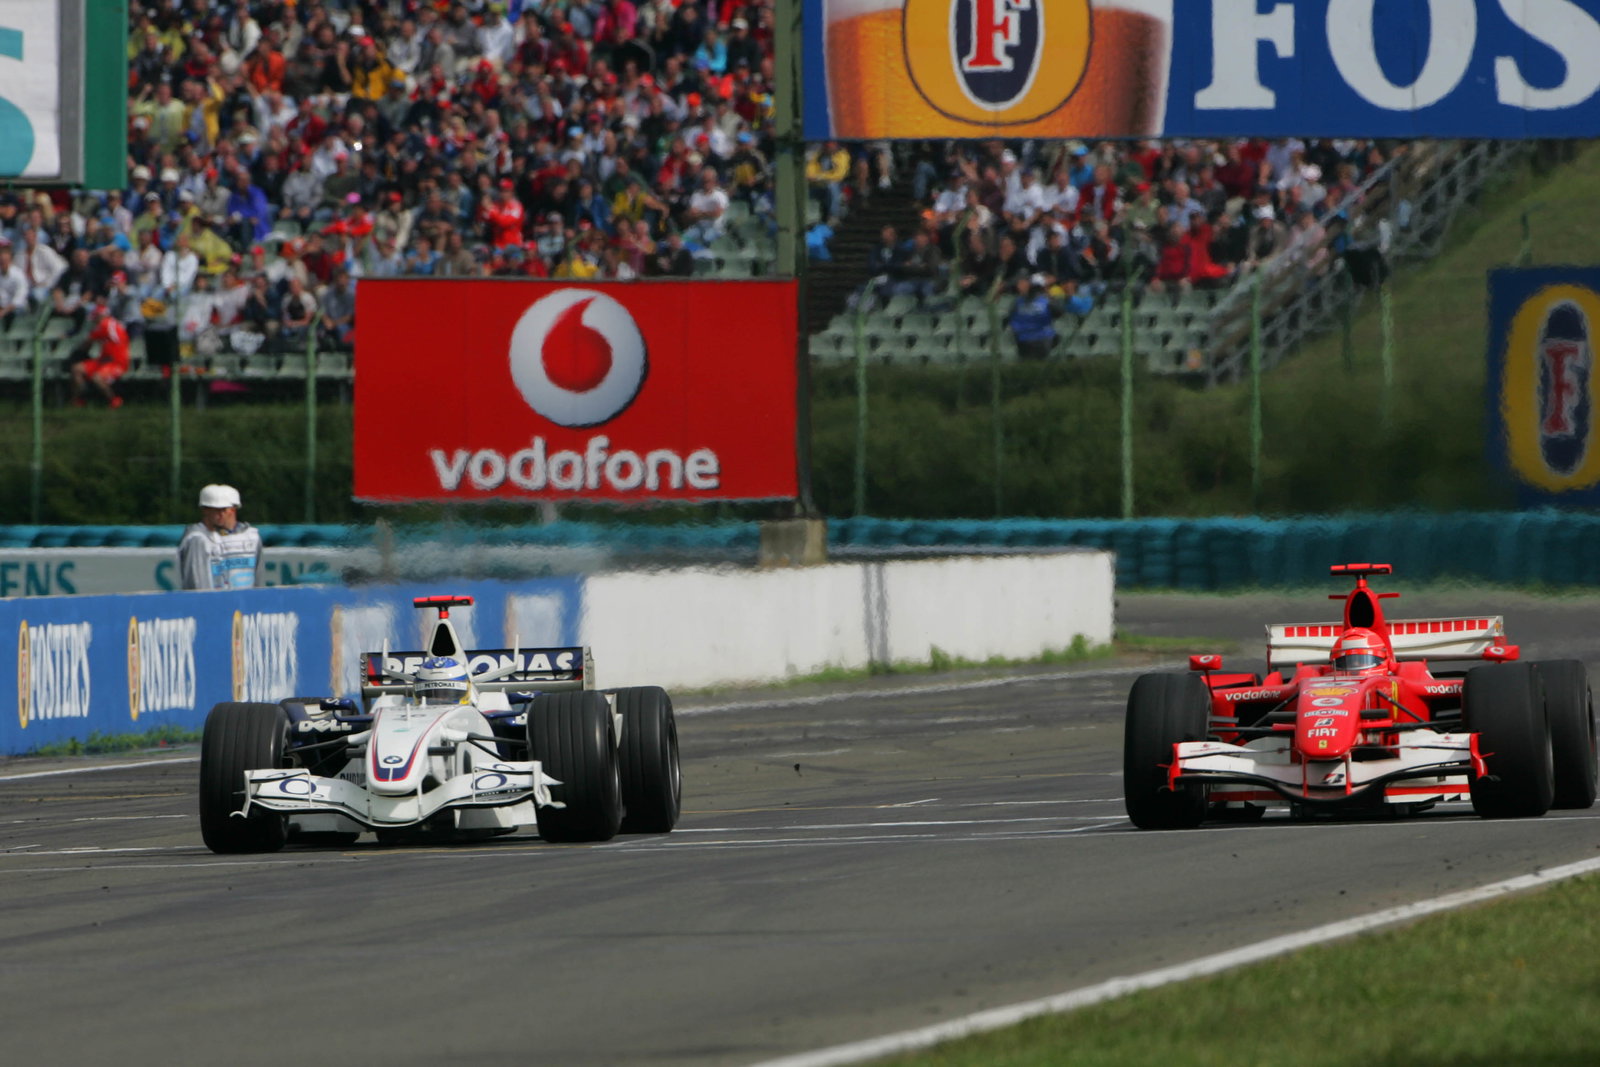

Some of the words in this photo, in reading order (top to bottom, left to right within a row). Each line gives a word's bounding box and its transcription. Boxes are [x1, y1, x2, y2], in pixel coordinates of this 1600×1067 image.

[1194, 0, 1600, 111] FOS
[430, 435, 720, 490] vodafone
[383, 652, 574, 683] PEONAS
[1225, 689, 1280, 701] vodafone
[1424, 684, 1463, 694] vodaf
[298, 720, 352, 732] DELL
[1308, 728, 1338, 738] FIAT
